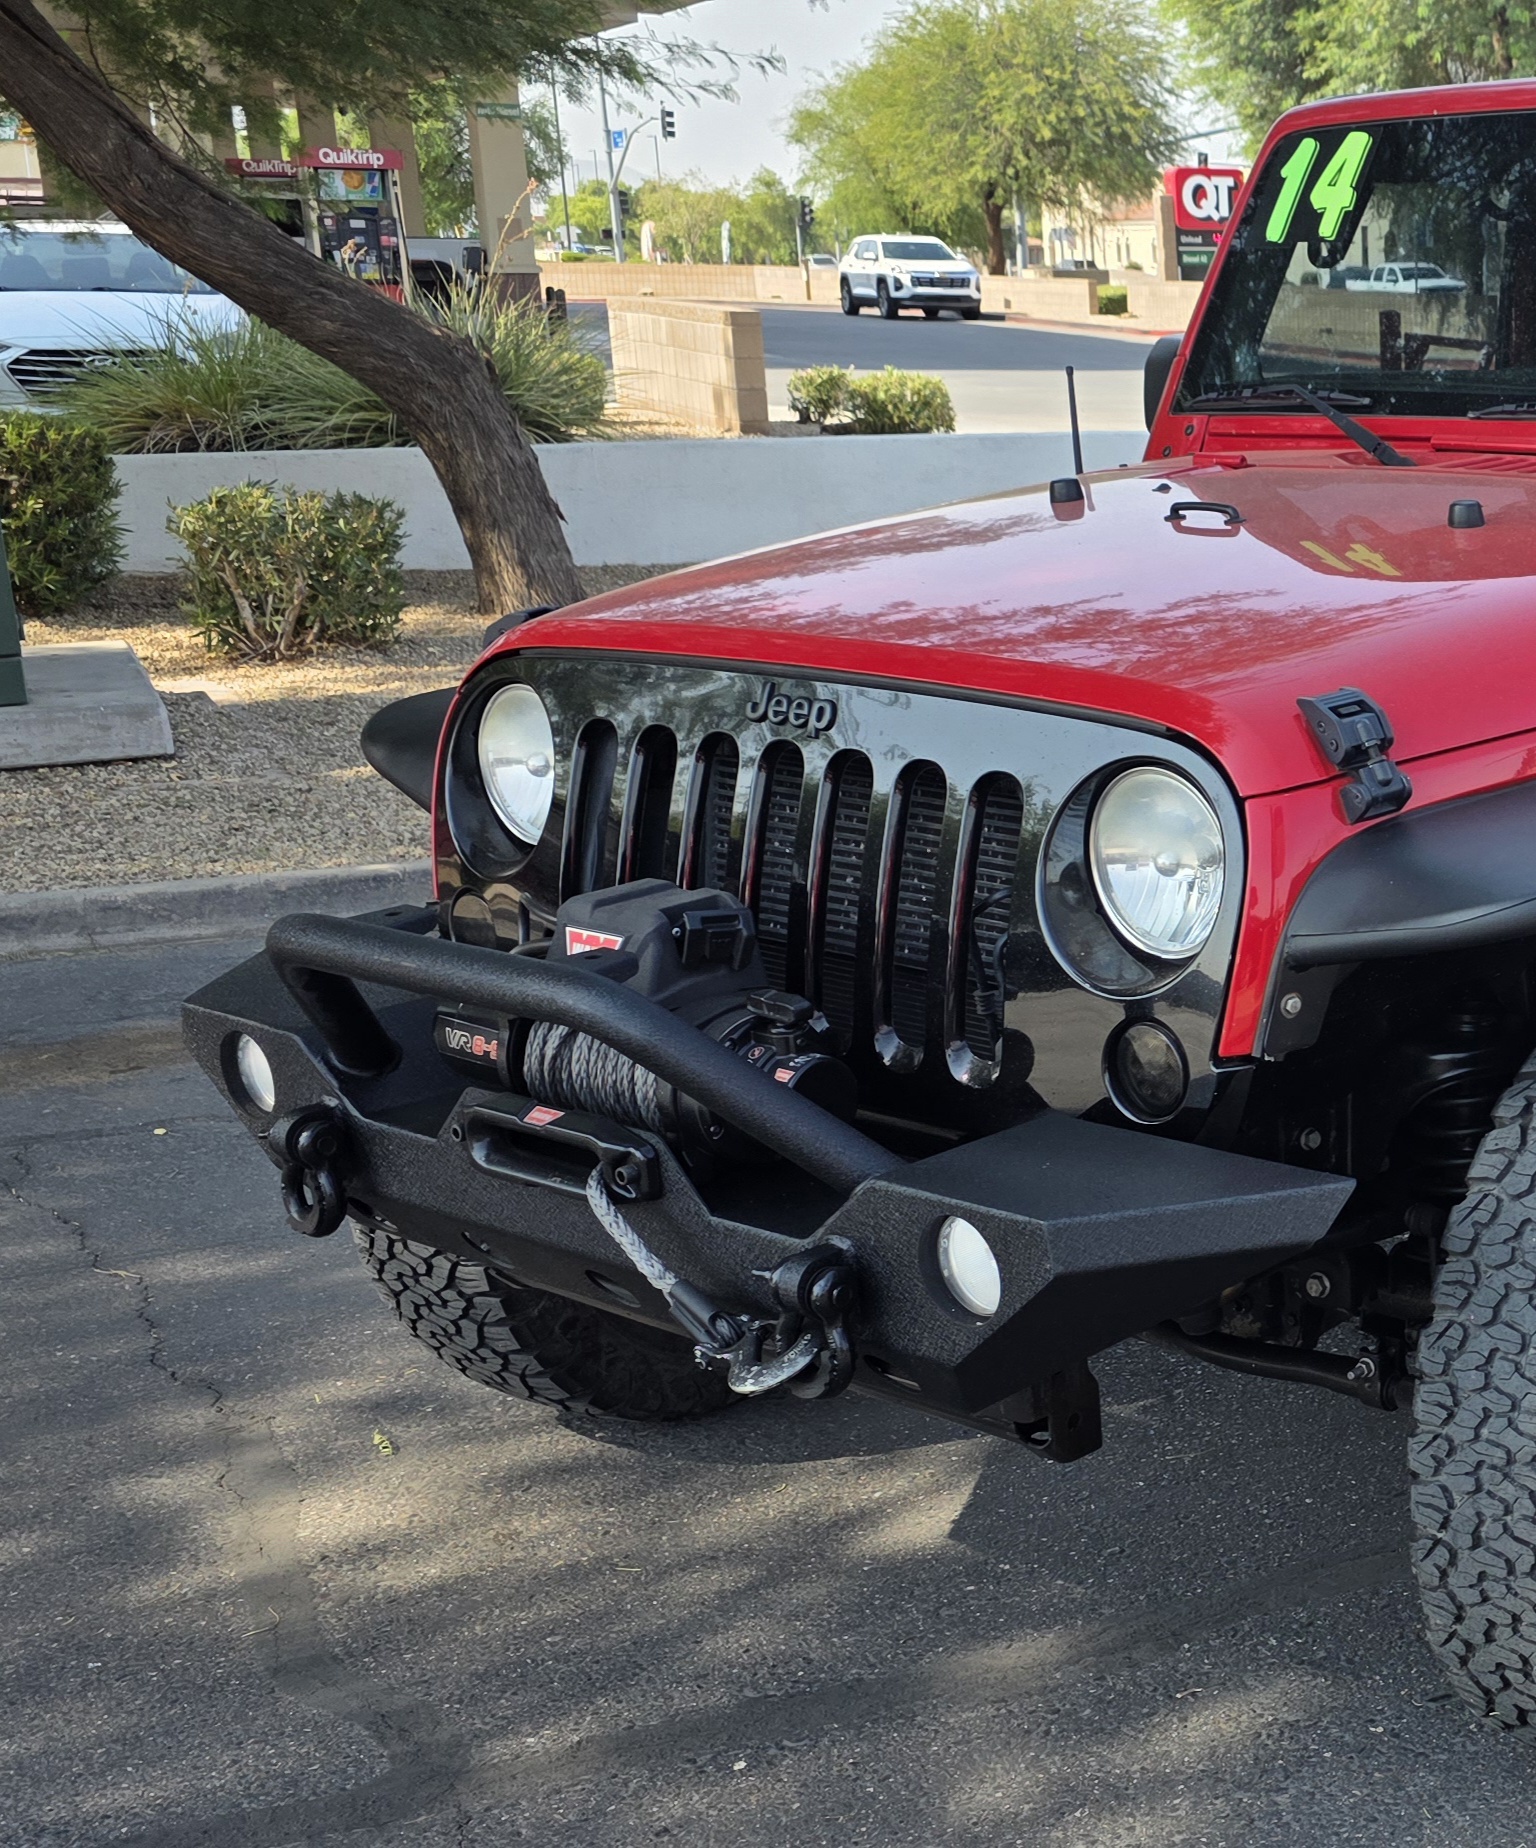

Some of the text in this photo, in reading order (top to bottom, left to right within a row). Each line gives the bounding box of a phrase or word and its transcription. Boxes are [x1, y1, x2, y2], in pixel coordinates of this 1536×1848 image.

[242, 159, 298, 176] QuikTrip
[318, 147, 385, 168] QuikTrip
[1182, 173, 1235, 222] QT
[1265, 130, 1374, 244] 14
[746, 682, 838, 739] Jeep
